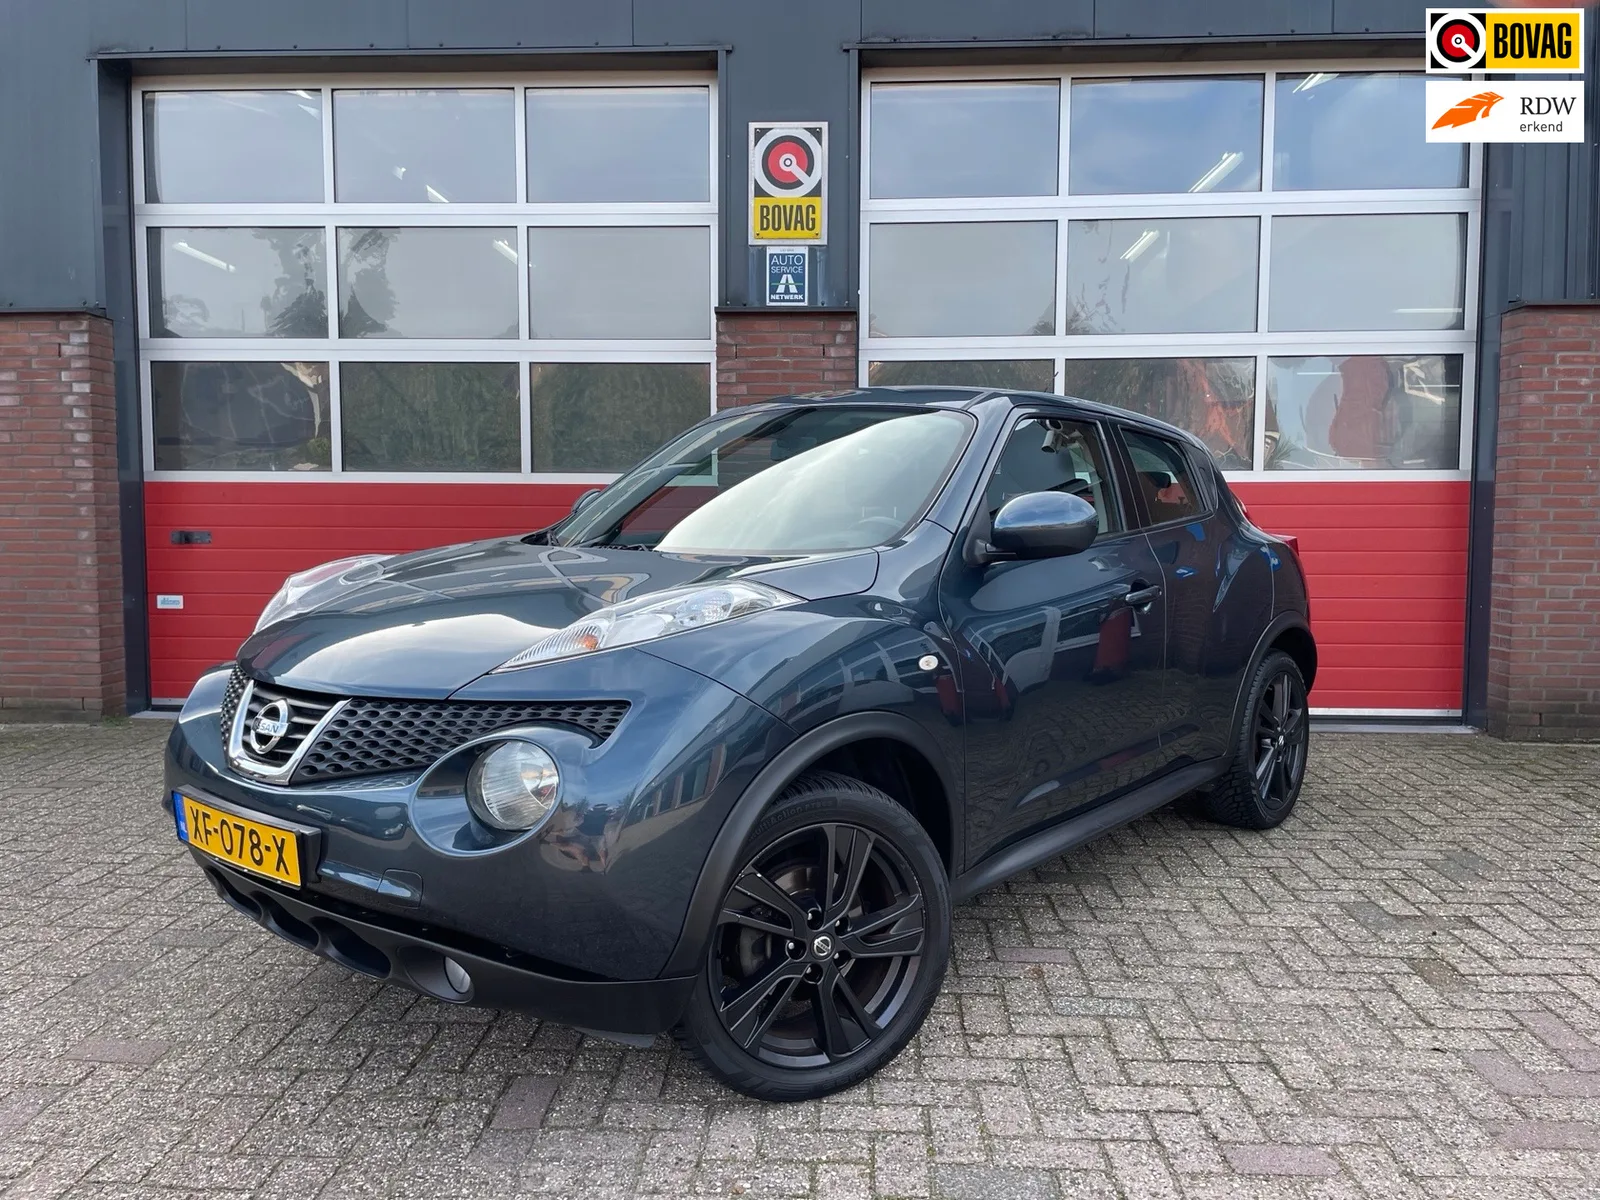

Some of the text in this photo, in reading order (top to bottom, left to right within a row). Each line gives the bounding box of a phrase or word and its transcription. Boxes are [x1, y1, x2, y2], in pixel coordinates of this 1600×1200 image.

[760, 204, 816, 231] BOVAG
[771, 254, 803, 265] AUTO
[190, 806, 290, 875] XF-078-X
